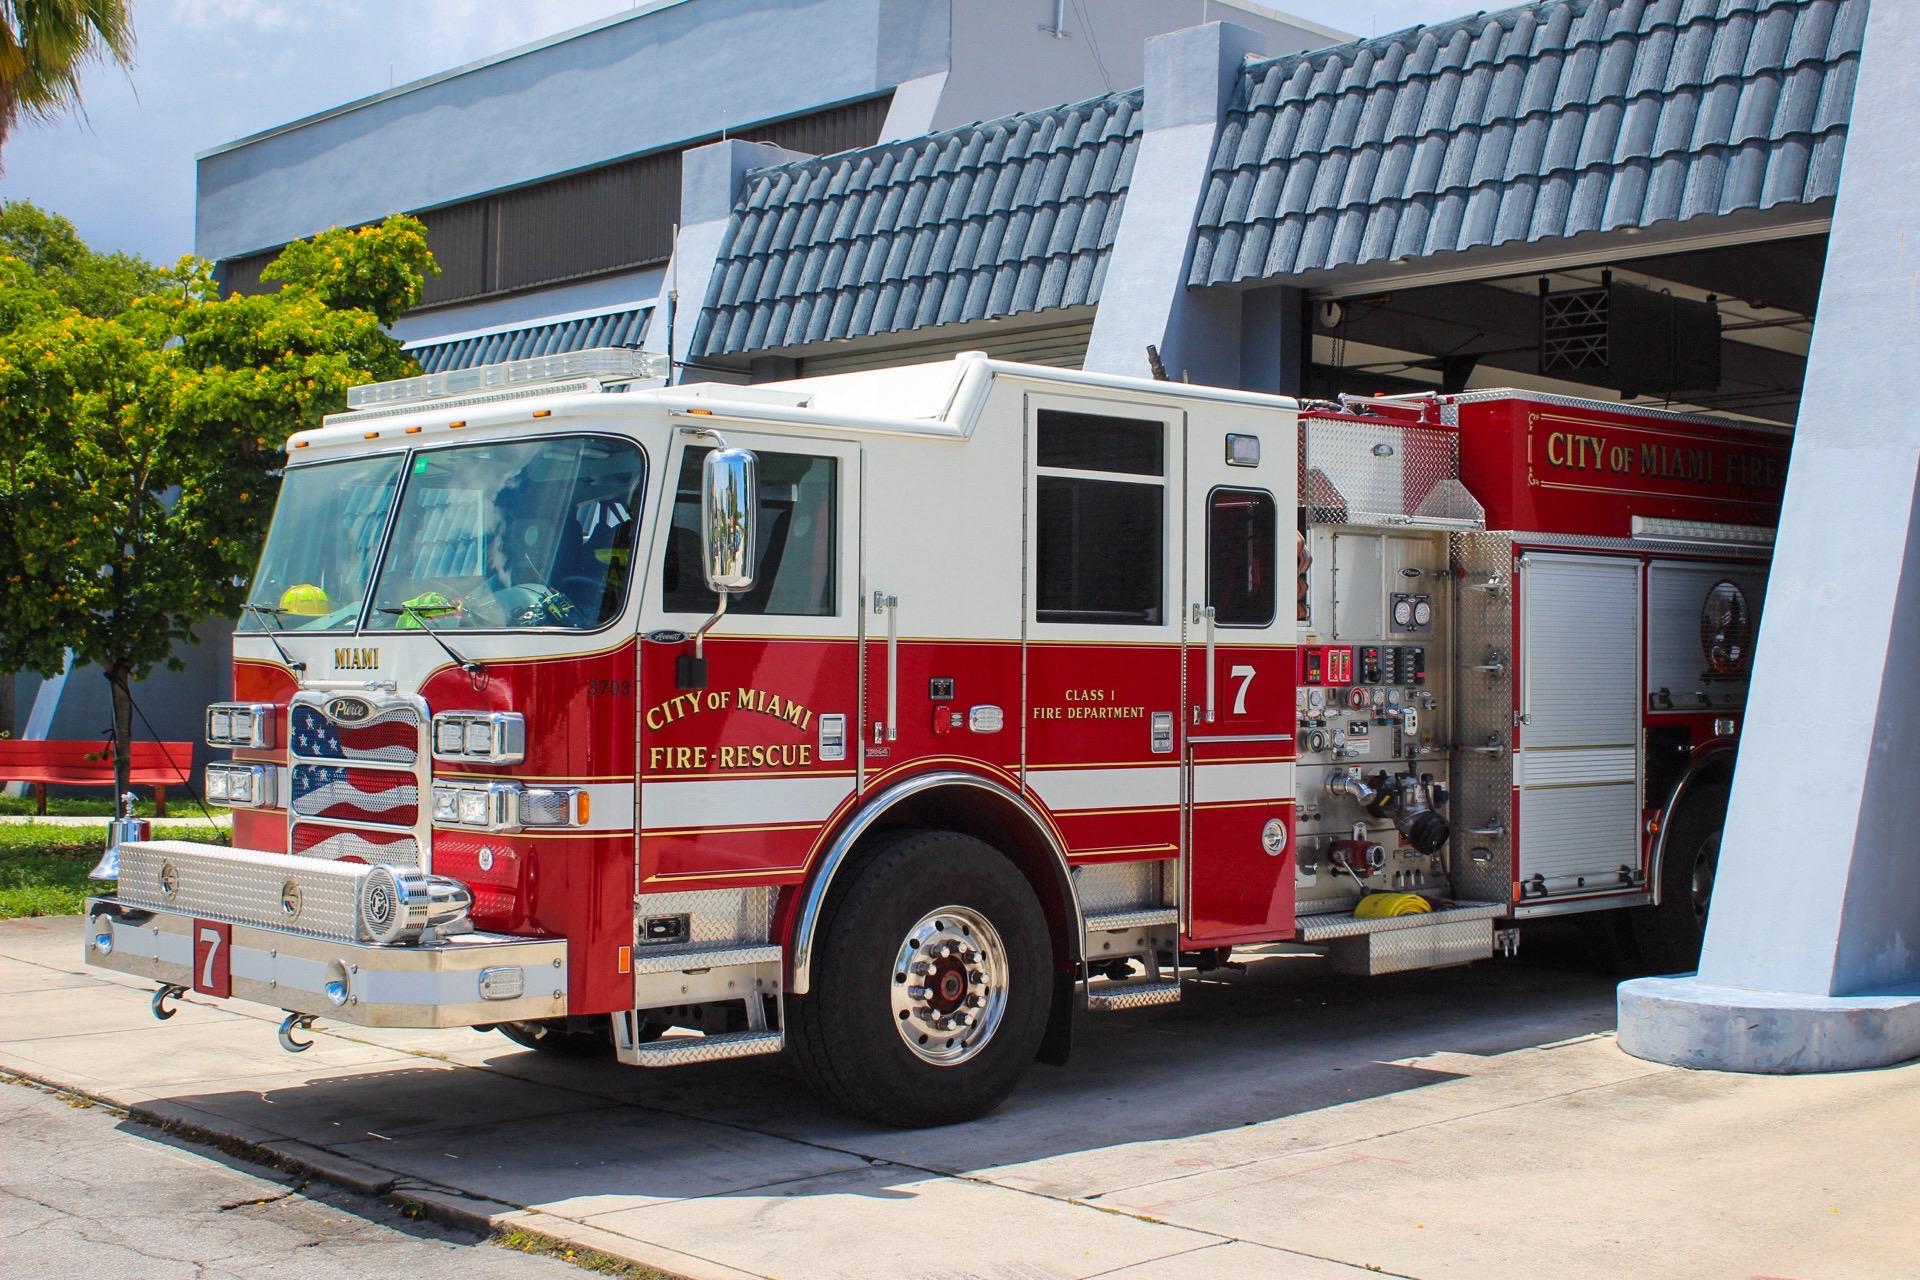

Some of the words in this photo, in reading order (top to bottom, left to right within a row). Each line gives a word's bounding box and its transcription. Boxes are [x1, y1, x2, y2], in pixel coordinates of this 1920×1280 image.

[1548, 432, 1607, 472] CITY
[1610, 446, 1634, 473] OF
[1640, 443, 1713, 483] MIAMI
[335, 648, 379, 669] MIAMI
[588, 679, 631, 697] 3703
[1065, 689, 1105, 701] CLASS
[1231, 665, 1256, 714] 7
[334, 700, 365, 718] Pierce
[646, 690, 702, 730] CITY
[707, 691, 731, 710] OF
[738, 688, 813, 731] MIAMI
[1033, 707, 1062, 719] FIRE
[1067, 706, 1145, 719] DEPARTMENT
[200, 927, 222, 989] 7
